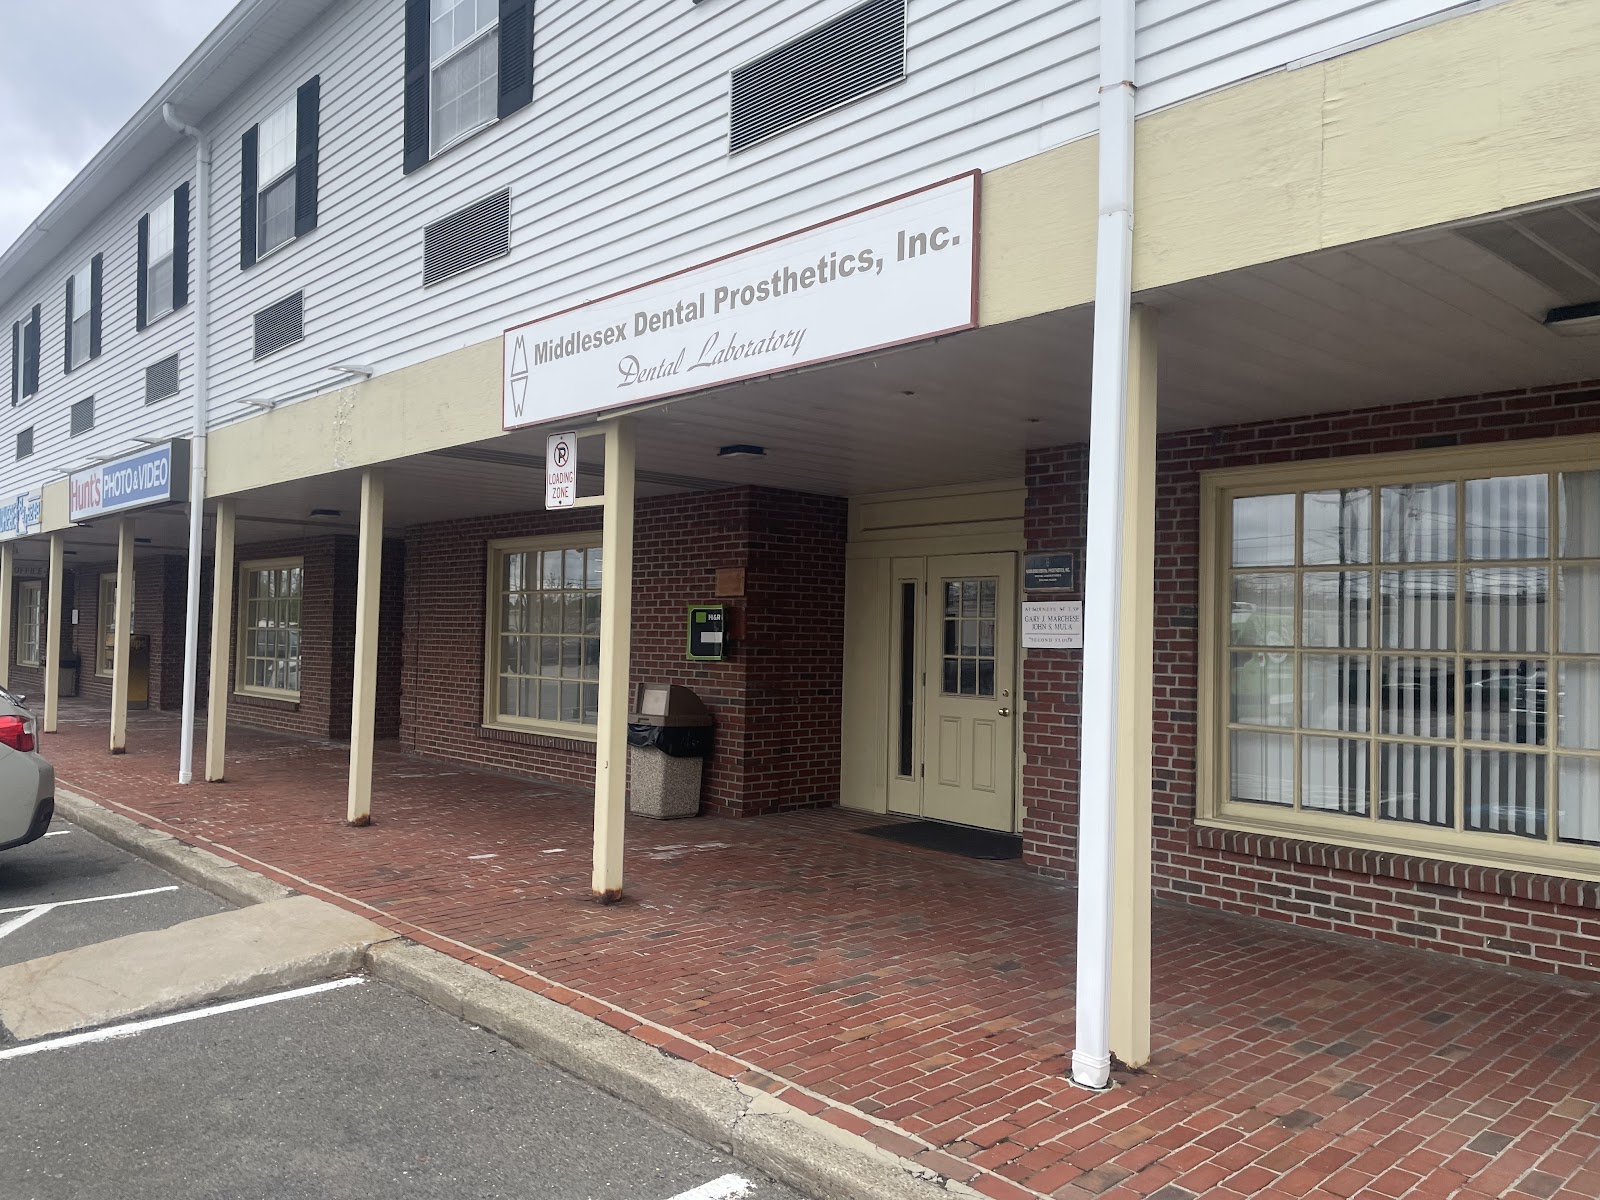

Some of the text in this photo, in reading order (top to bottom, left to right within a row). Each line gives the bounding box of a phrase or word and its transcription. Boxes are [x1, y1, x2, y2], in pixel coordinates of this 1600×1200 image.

[534, 226, 960, 365] Middlesex Dental Prosthetics, Inc.
[617, 328, 807, 389] Dental Laboratory
[71, 473, 101, 513] Hunt's
[549, 472, 573, 485] LOADING
[552, 487, 569, 498] ZONE
